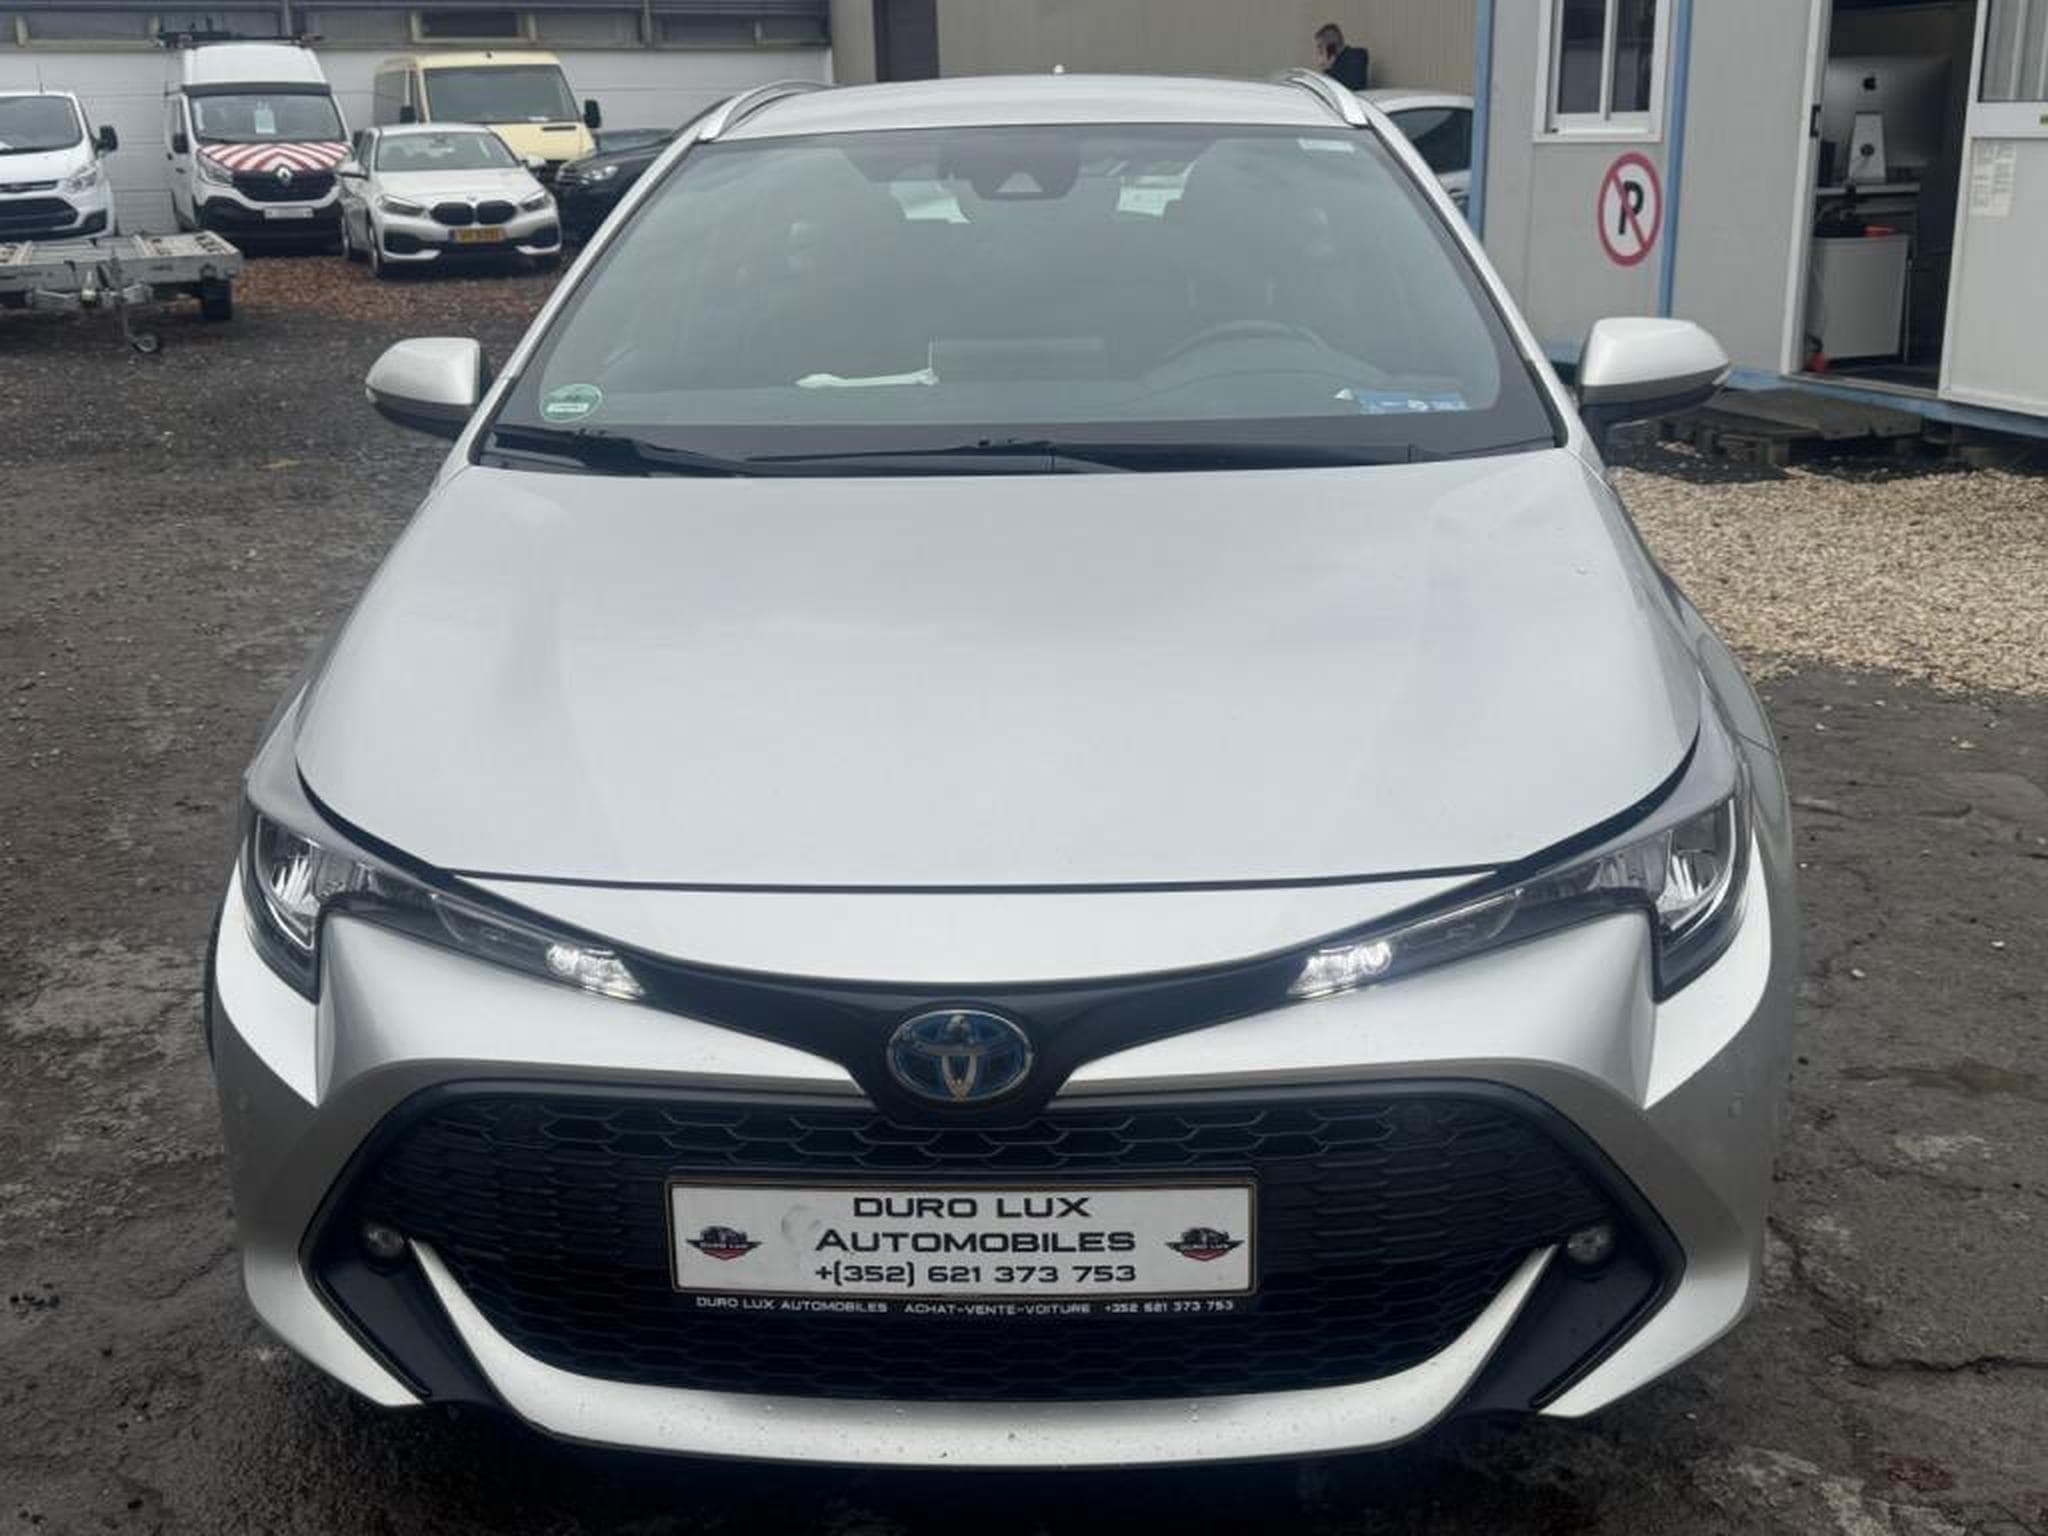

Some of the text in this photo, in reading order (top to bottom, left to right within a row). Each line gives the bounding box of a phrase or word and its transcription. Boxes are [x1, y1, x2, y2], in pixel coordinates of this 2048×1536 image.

[1618, 180, 1644, 235] P
[853, 1197, 1091, 1218] DURO LUX
[815, 1228, 1136, 1253] AUTOMOBILES
[815, 1260, 1136, 1287] +(352) 621 373 753
[696, 1296, 738, 1308] DURO
[743, 1299, 775, 1310] LUX
[779, 1302, 888, 1313] AUTOMOBILES
[904, 1304, 1090, 1315] ACHAT-VENTE-VOITURE
[1173, 1302, 1201, 1312] 373
[1206, 1301, 1234, 1311] 753
